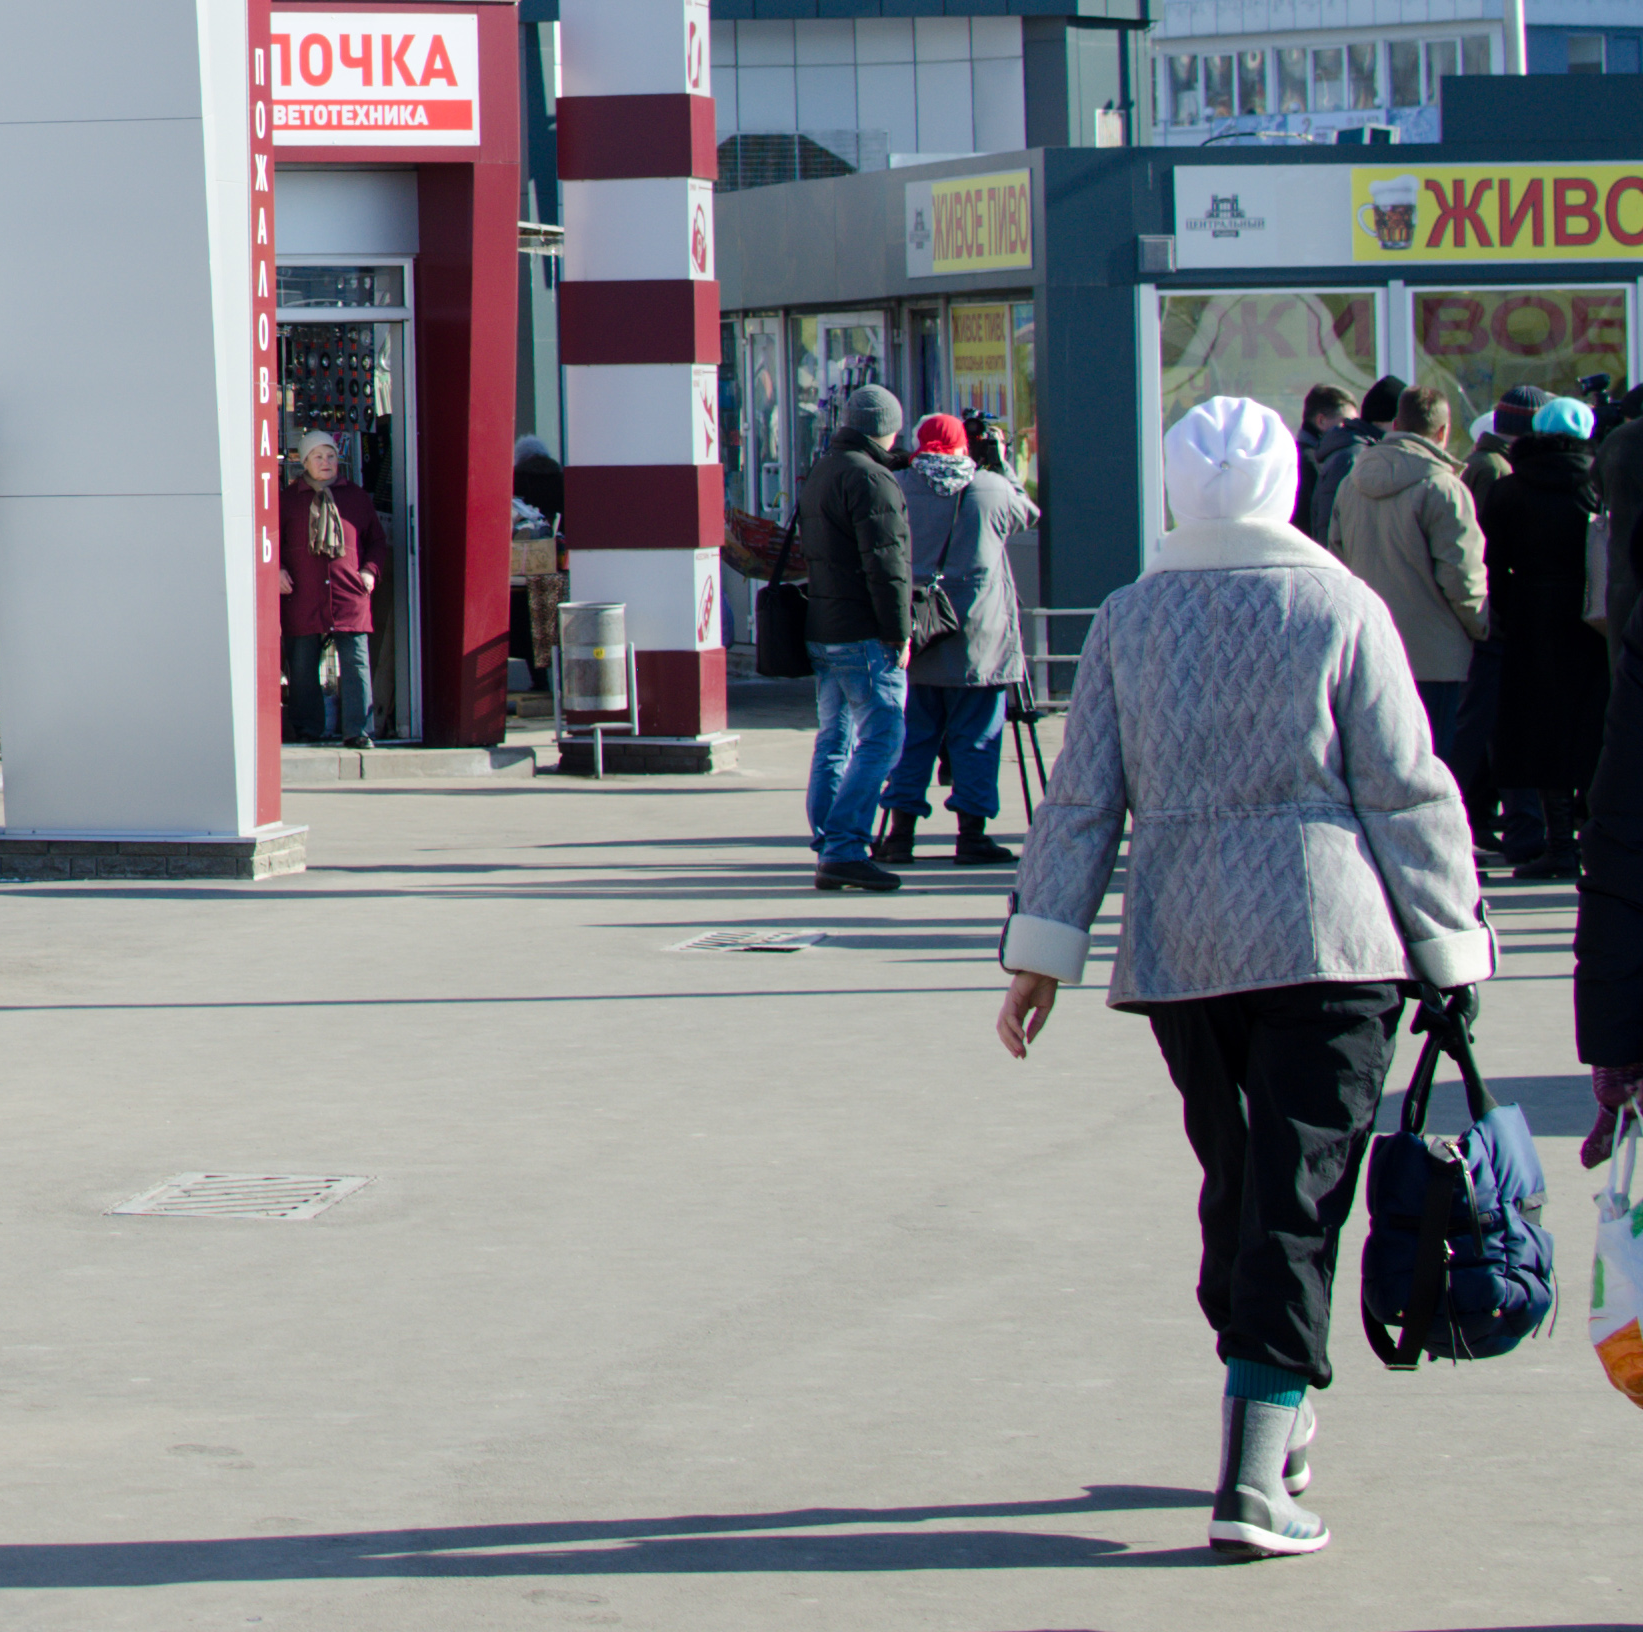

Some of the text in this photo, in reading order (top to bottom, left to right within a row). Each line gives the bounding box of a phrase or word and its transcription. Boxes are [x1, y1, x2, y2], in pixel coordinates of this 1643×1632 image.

[254, 48, 272, 563] ПОЖАЛОВАТЬ
[932, 183, 1029, 260] ЖИВОЕ ПИВО
